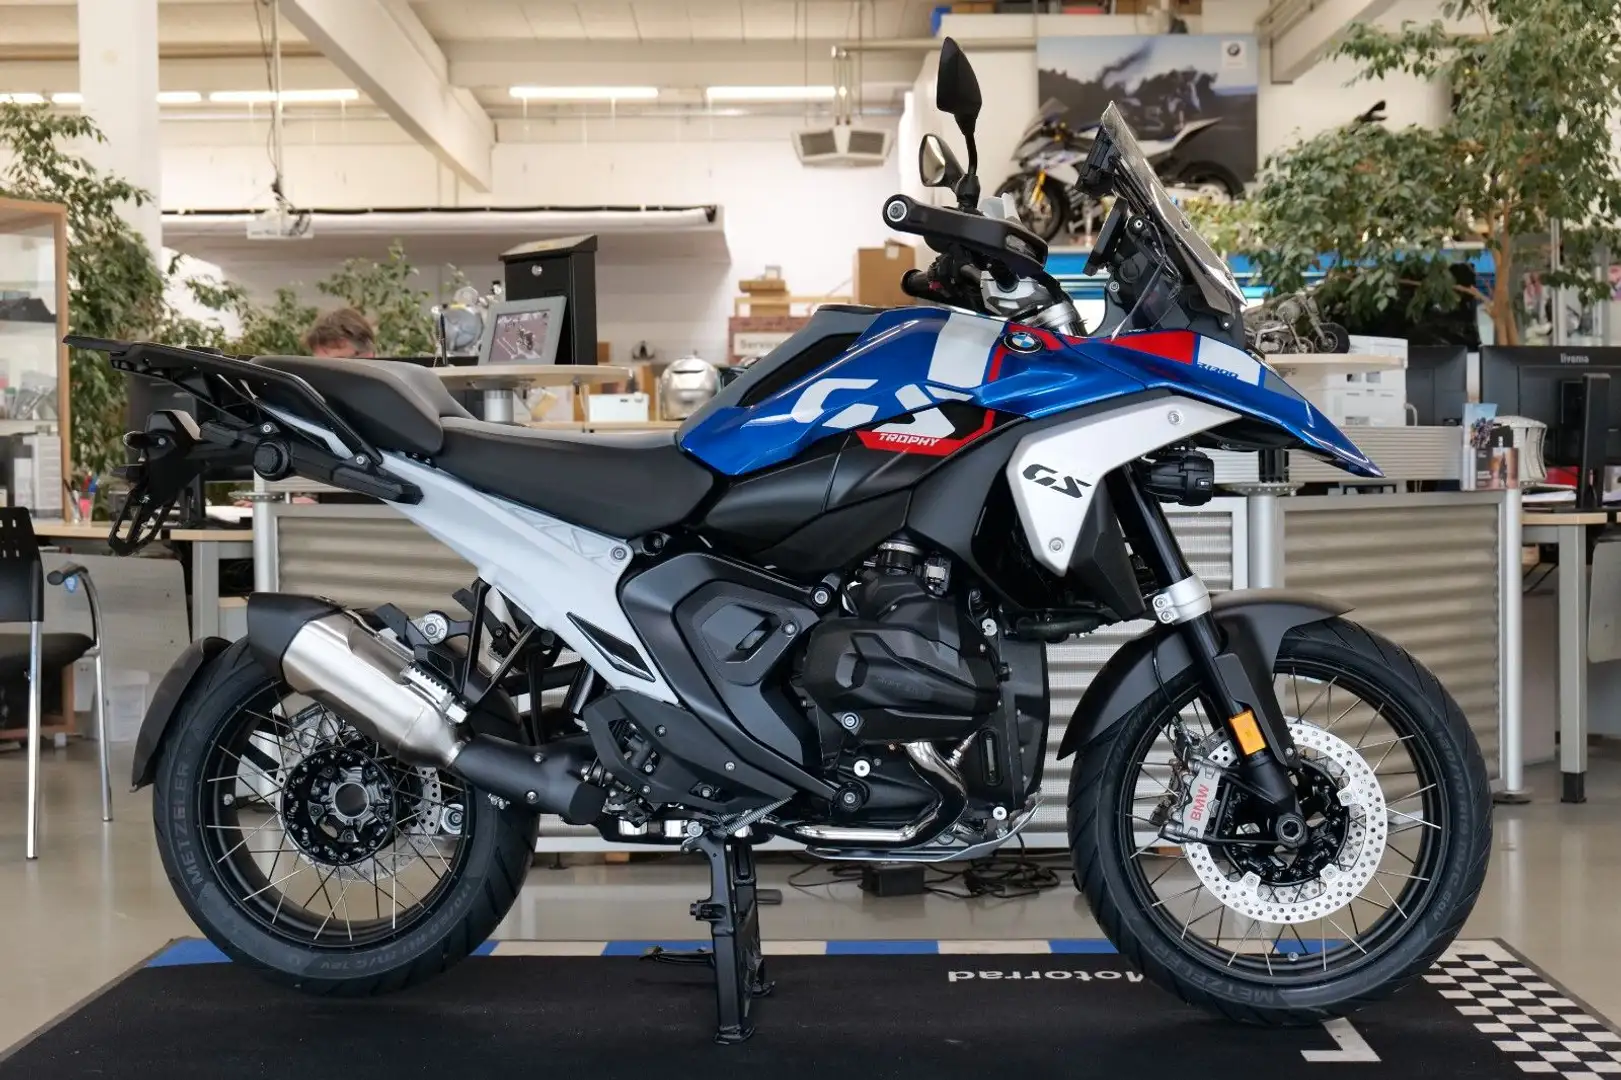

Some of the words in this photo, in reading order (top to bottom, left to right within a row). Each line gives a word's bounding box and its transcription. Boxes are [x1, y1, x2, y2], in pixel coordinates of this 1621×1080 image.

[790, 378, 974, 438] GS
[879, 432, 940, 447] TROPHY
[1022, 463, 1092, 498] GS
[1190, 783, 1209, 821] BMW
[173, 761, 204, 887] METZELER
